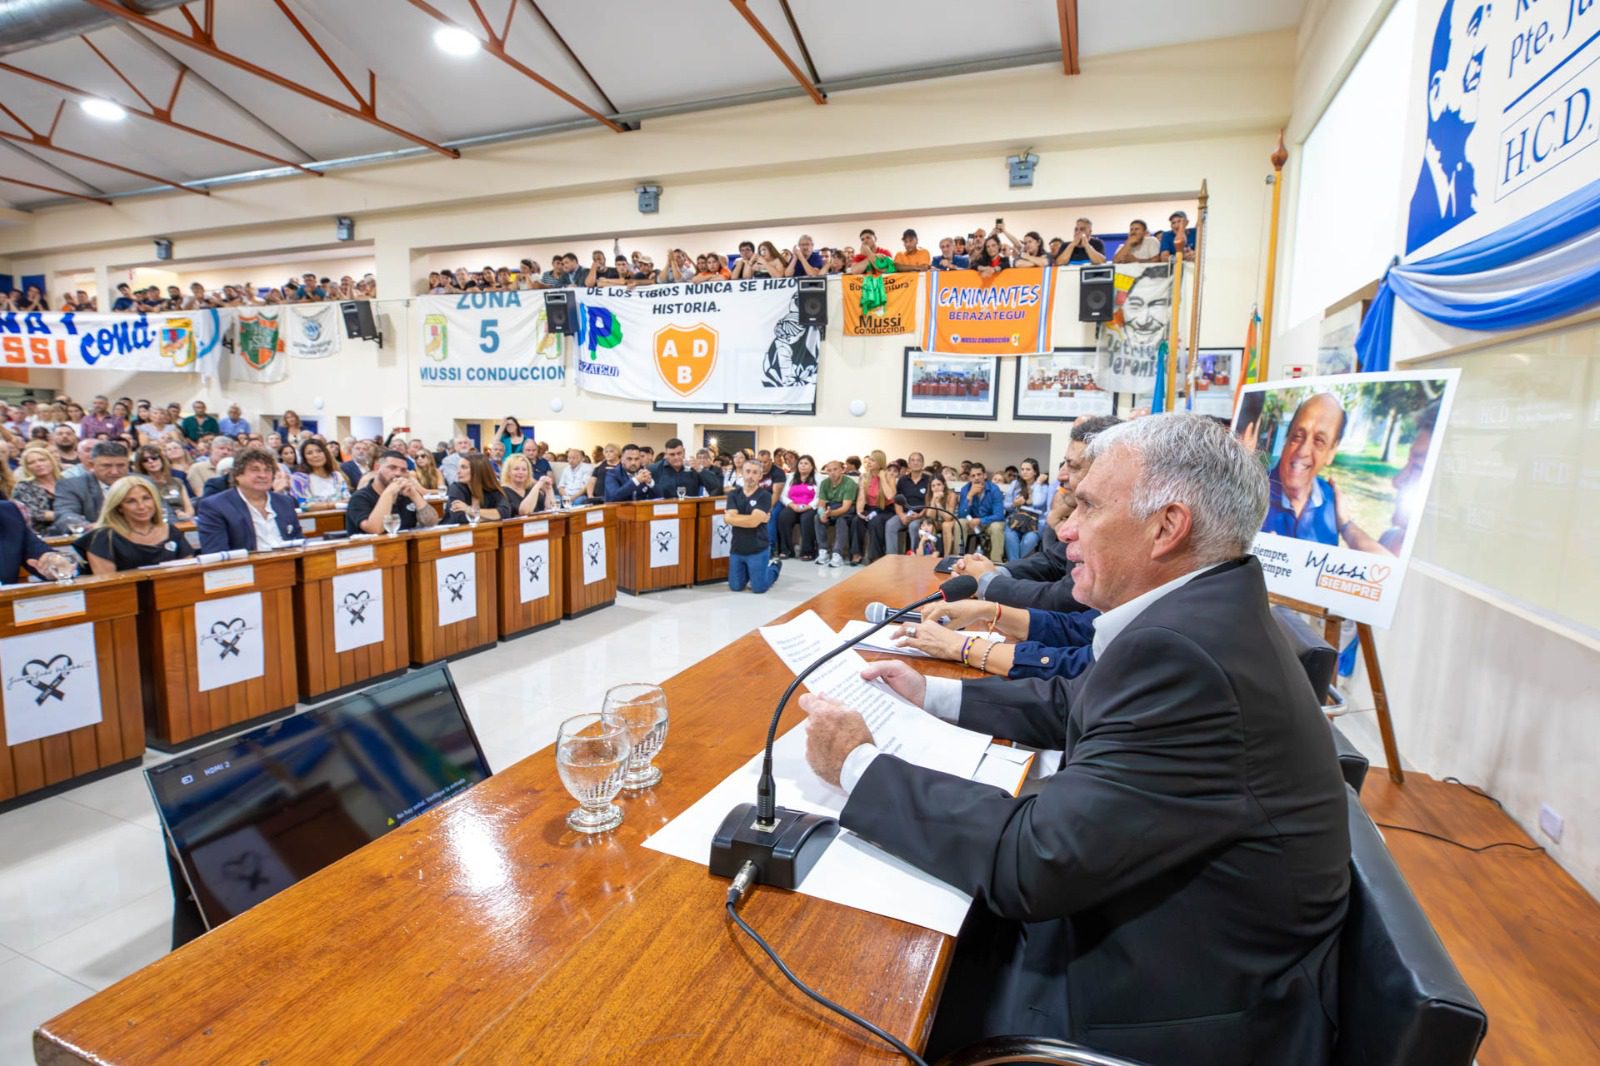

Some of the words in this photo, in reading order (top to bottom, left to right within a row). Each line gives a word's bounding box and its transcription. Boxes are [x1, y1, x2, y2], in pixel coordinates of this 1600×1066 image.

[1509, 20, 1554, 79] Pte.
[1502, 87, 1593, 185] H.C.D.
[685, 282, 733, 296] NUNCA
[739, 280, 757, 293] SE
[763, 278, 798, 291] HIZO
[938, 284, 1041, 309] CAMINANTES
[456, 291, 521, 309] ZONA
[652, 301, 721, 315] HISTORIA.
[859, 313, 902, 328] Mussi
[949, 311, 1026, 321] BERAZATEGUI
[479, 319, 500, 353] 5
[3, 337, 67, 364] SSI
[662, 339, 679, 358] A
[692, 339, 709, 358] D
[420, 367, 461, 380] MUSSI
[466, 366, 565, 381] CONDUCCION
[676, 365, 693, 384] B
[1252, 544, 1290, 563] siempre,
[1261, 559, 1292, 578] iempre
[1305, 550, 1369, 587] Mussi
[1319, 576, 1381, 600] SIEMPRE
